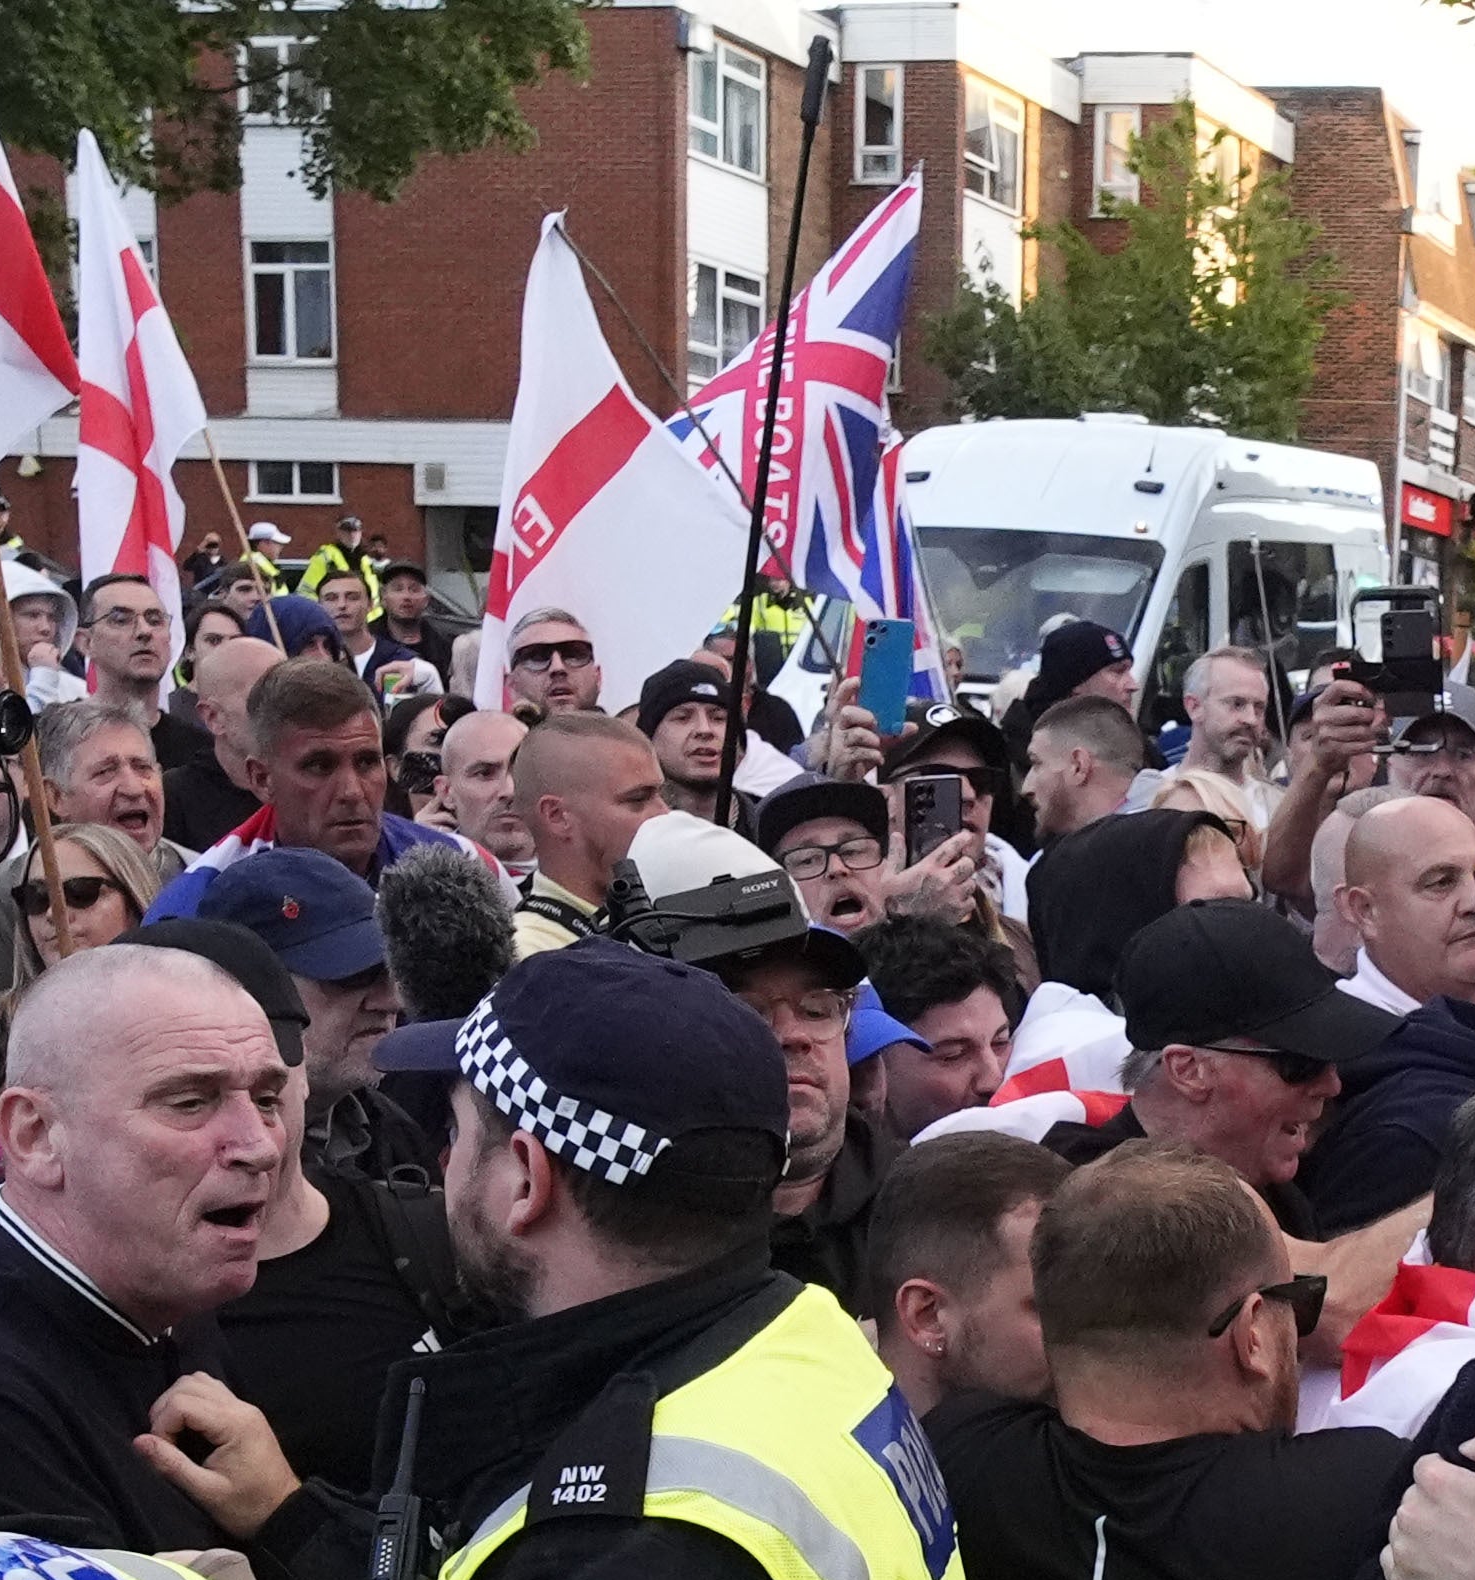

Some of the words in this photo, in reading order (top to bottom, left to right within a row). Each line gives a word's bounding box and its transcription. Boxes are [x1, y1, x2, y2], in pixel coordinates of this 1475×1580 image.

[741, 879, 780, 895] SONY
[559, 1464, 606, 1485] NW
[550, 1483, 608, 1506] 1402
